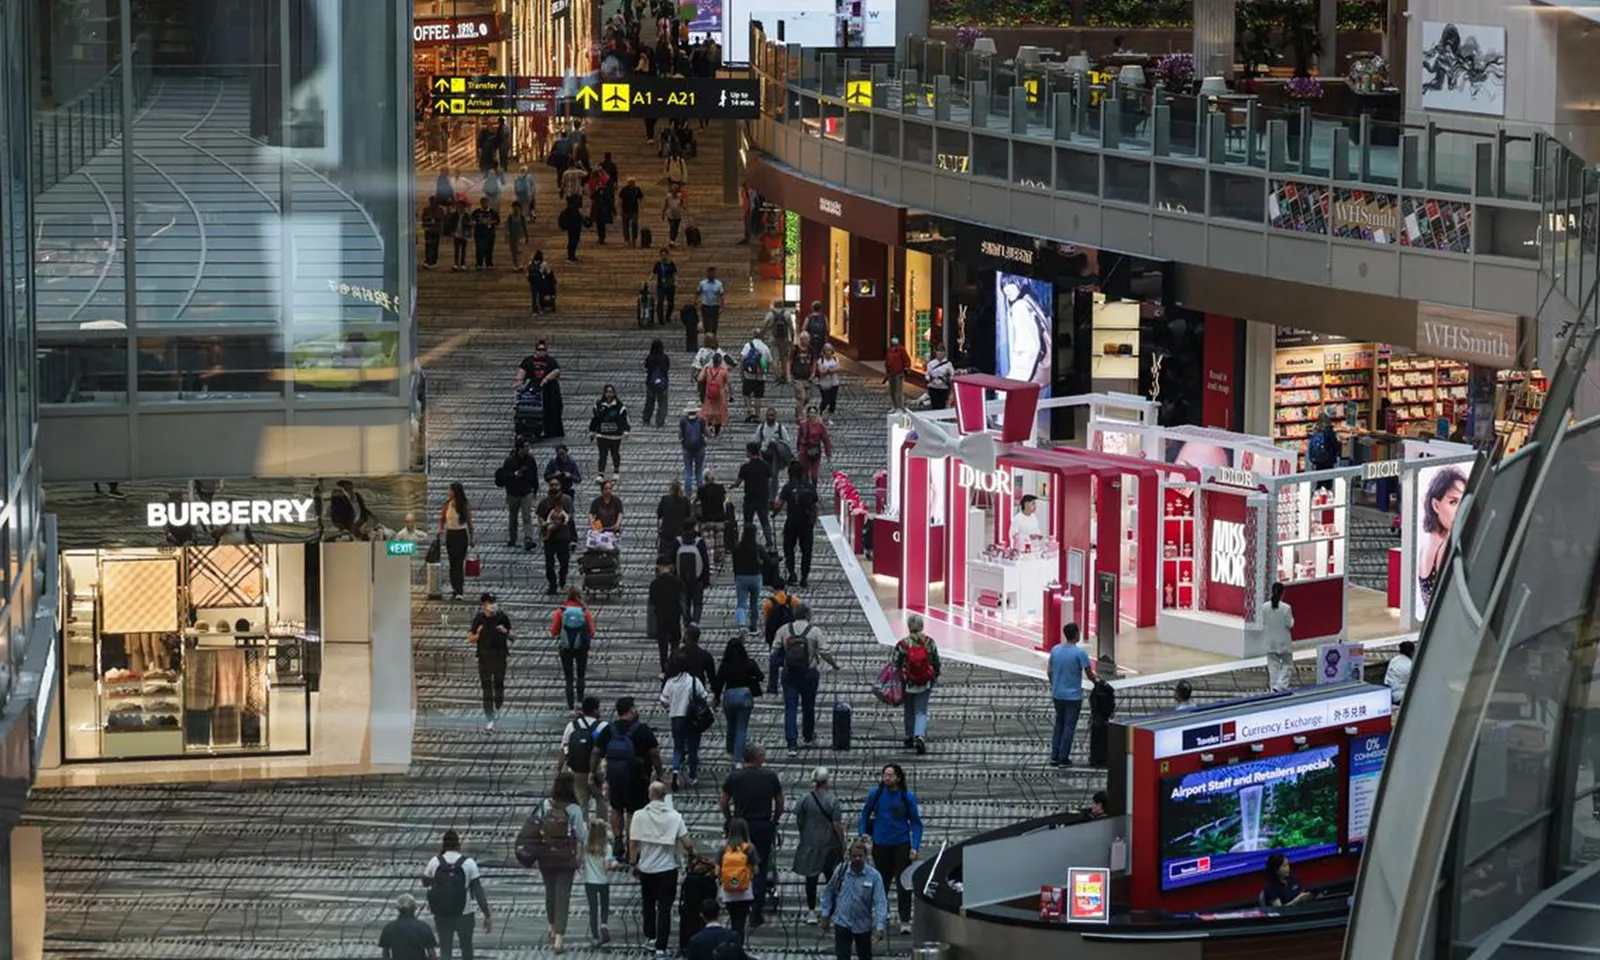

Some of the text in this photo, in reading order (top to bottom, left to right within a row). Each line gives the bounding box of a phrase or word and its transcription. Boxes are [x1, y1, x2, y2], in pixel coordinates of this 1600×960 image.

[467, 82, 506, 90] Transfer A
[632, 91, 652, 105] A1
[667, 91, 695, 105] A21
[730, 91, 749, 100] Up to
[1334, 203, 1396, 228] WHSmith
[1424, 320, 1510, 359] WHSmith
[958, 462, 1011, 496] DIOR
[1221, 467, 1254, 487] DIOR
[146, 497, 315, 527] BURBERRY
[393, 542, 415, 555] EXIT
[1212, 519, 1246, 555] MISS
[1211, 552, 1246, 587] DIOR
[1333, 704, 1367, 721] 外币兑换
[1241, 719, 1282, 738] Currency
[1283, 714, 1323, 731] Exchange
[1366, 737, 1380, 751] 0%
[1170, 758, 1331, 798] Airport Staff and Retailers special
